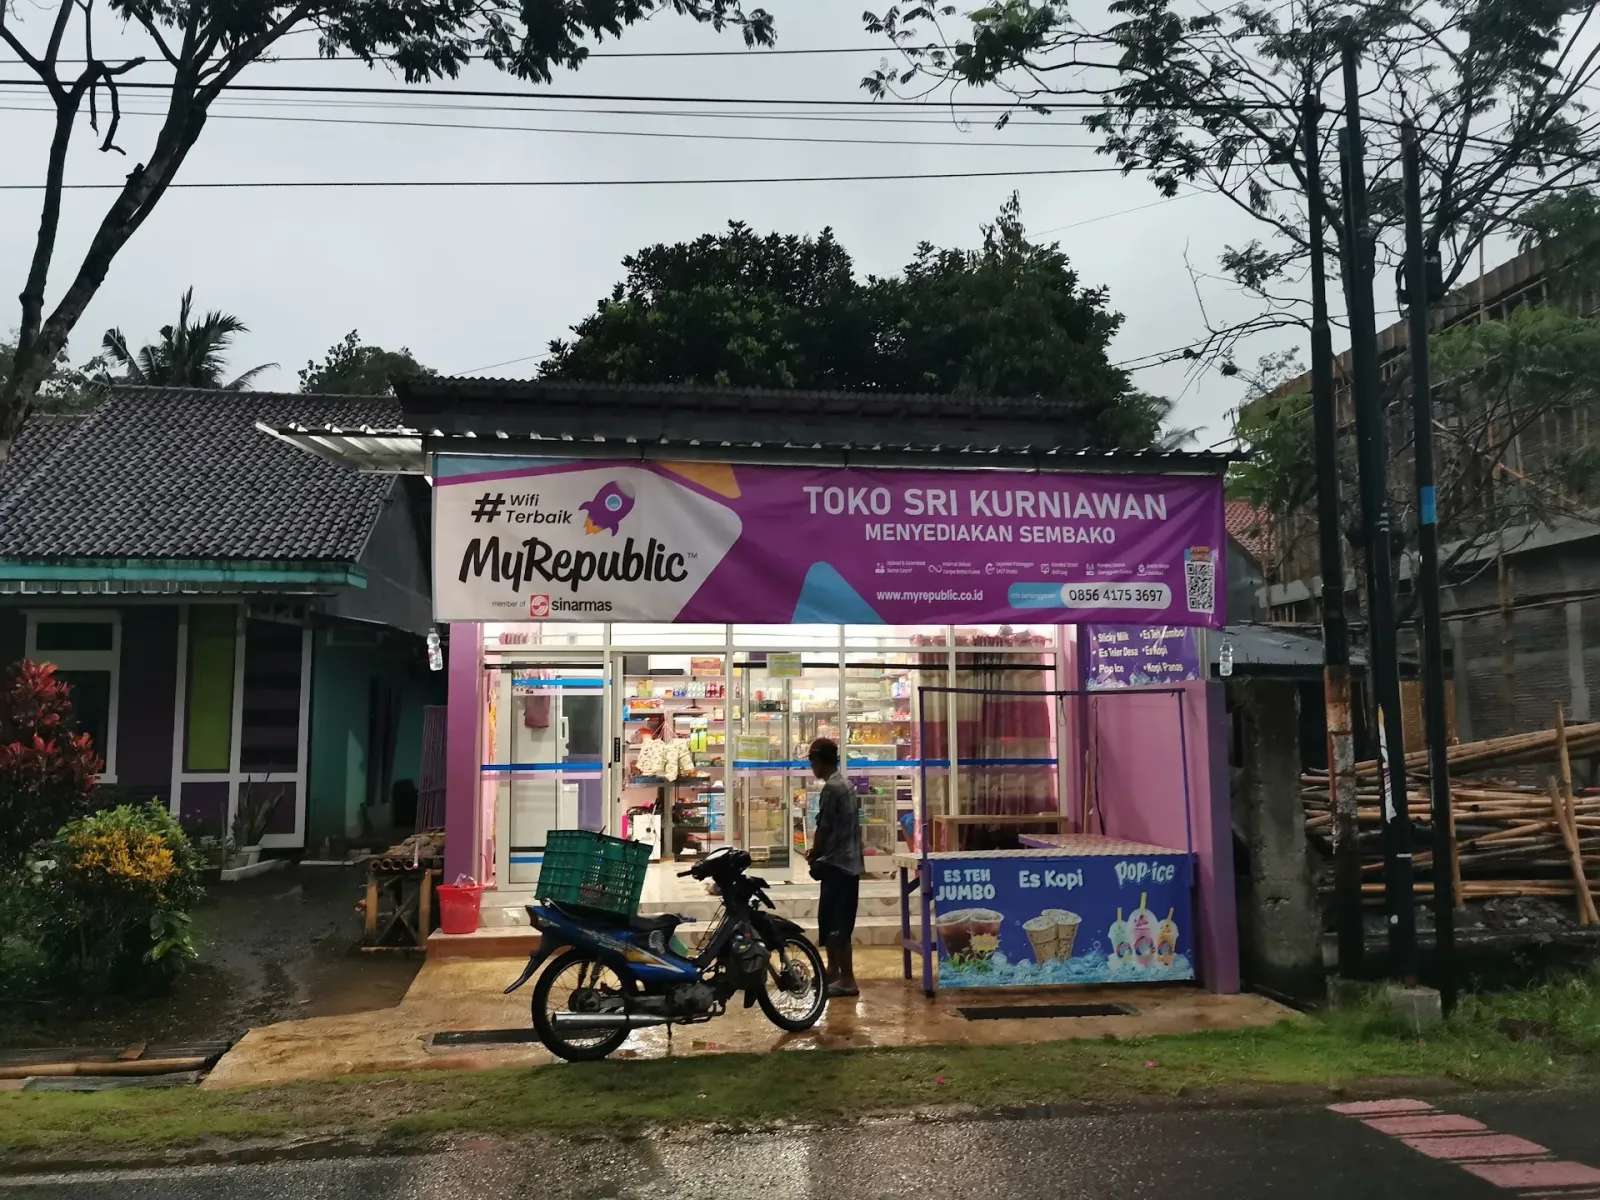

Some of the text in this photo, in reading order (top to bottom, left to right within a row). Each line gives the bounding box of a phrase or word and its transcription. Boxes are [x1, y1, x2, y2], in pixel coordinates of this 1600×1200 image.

[509, 494, 540, 507] Wifi
[803, 486, 1167, 520] TOKO SRI KURNIAWAN
[506, 510, 573, 524] Terbaik
[865, 523, 1116, 544] MENYEDIAKAN SEMBAKO
[458, 535, 689, 593] MyRepublic
[876, 589, 984, 604] www.myrepublic.co.id
[1069, 589, 1163, 601] 0856 4175 3697
[551, 597, 612, 612] sinarmas
[1099, 649, 1108, 658] Es
[943, 869, 991, 883] ES TEH
[1018, 869, 1083, 890] Es Kopi
[936, 884, 995, 901] JUMBO
